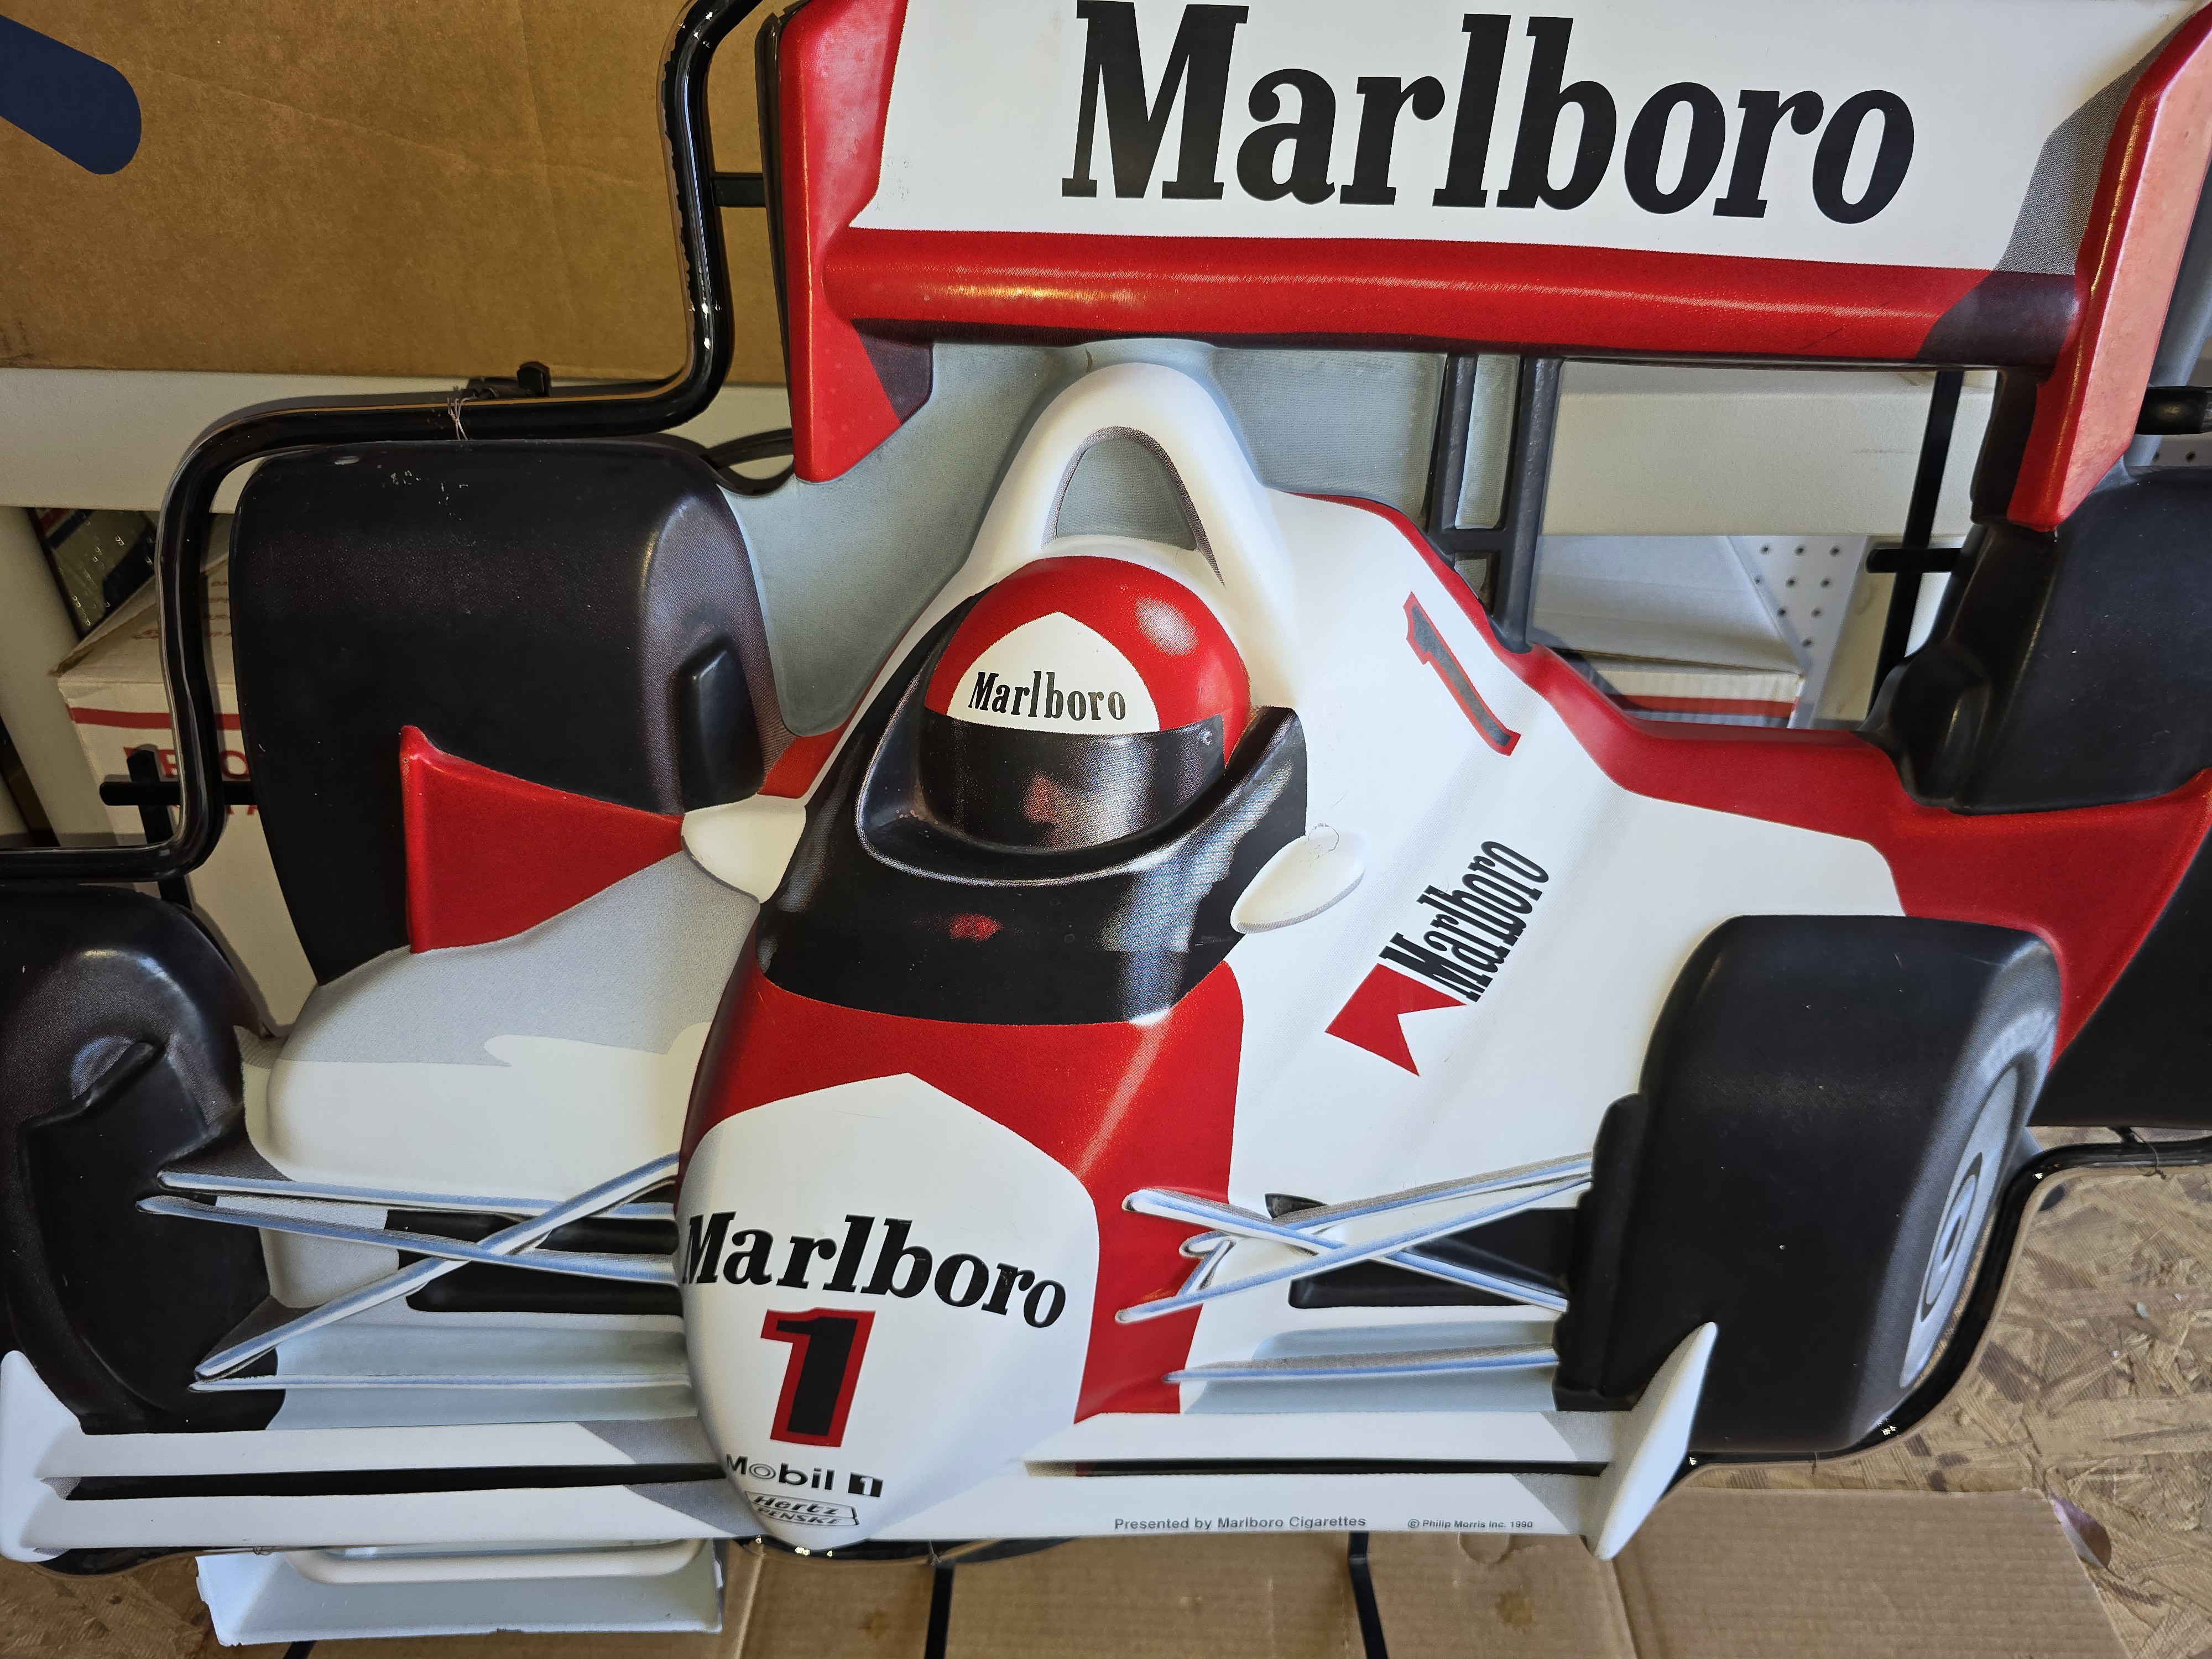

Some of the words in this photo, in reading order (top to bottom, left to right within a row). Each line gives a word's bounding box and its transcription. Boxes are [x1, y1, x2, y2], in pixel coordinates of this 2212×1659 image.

[1062, 0, 1914, 224] Marlboro
[968, 671, 1126, 720] Marlboro
[1403, 592, 1521, 755] 1
[1378, 841, 1549, 1002] Marlboro
[682, 1211, 1066, 1328] Marlboro
[760, 1307, 875, 1447] 1
[726, 1454, 835, 1490] Mobil
[753, 1496, 839, 1515] Hertz
[757, 1507, 842, 1524] PENSKE
[1114, 1517, 1190, 1529] Presented
[1195, 1517, 1212, 1530] by
[1218, 1517, 1284, 1528] Marlboro
[1289, 1516, 1366, 1528] Cigarettes
[1422, 1519, 1451, 1528] Philip
[1454, 1520, 1486, 1528] Morris
